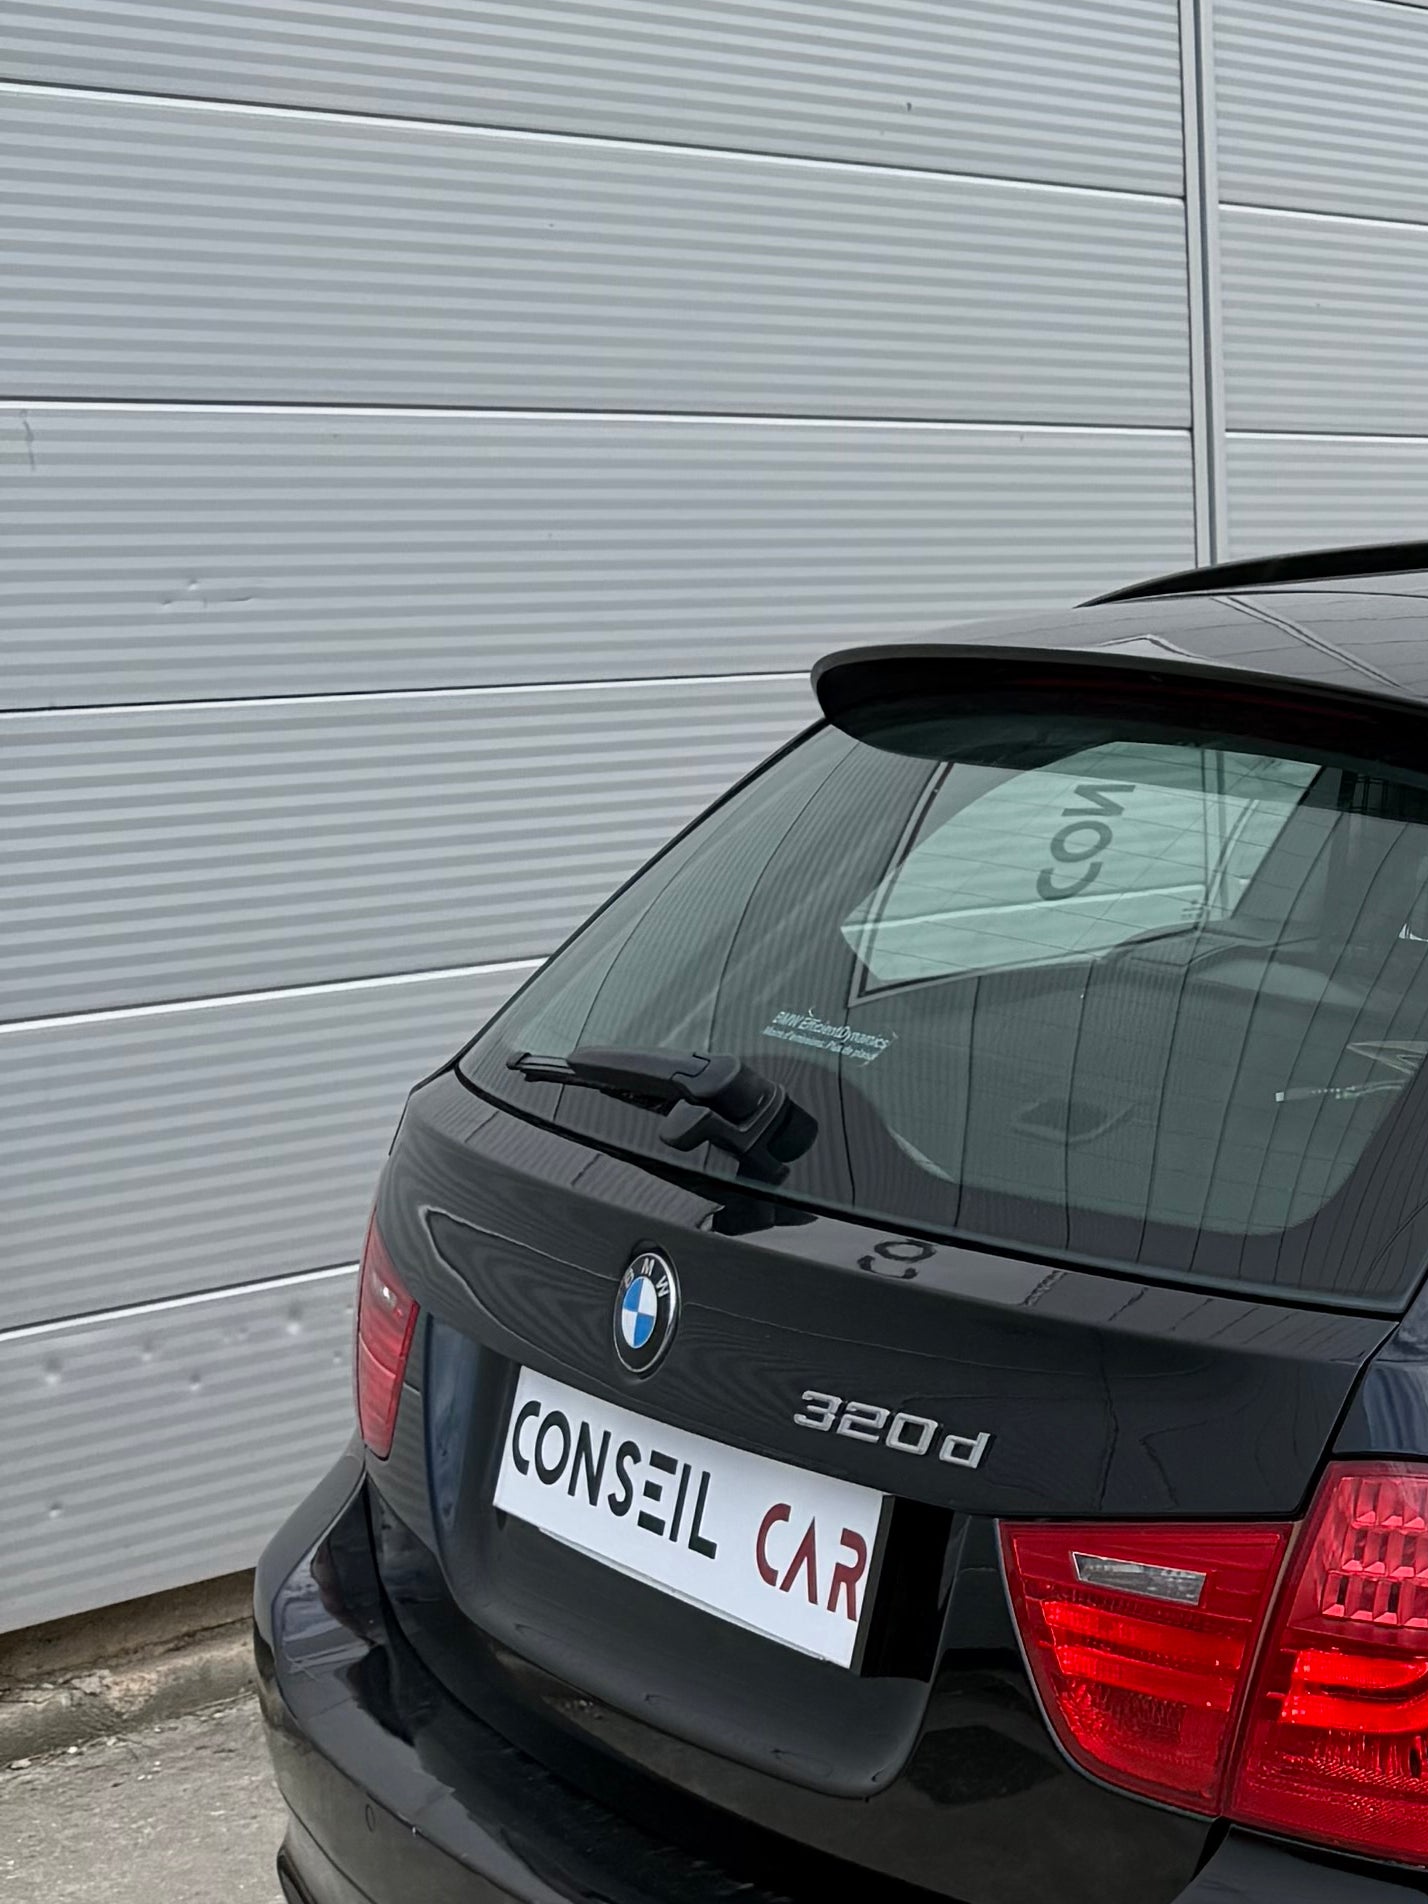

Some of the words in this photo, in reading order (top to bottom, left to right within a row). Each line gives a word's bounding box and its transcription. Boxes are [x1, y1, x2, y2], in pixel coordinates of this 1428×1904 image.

[623, 1257, 670, 1298] BMW
[793, 1389, 991, 1470] 320d
[510, 1400, 717, 1560] CONSEIL
[756, 1503, 868, 1622] CAR
